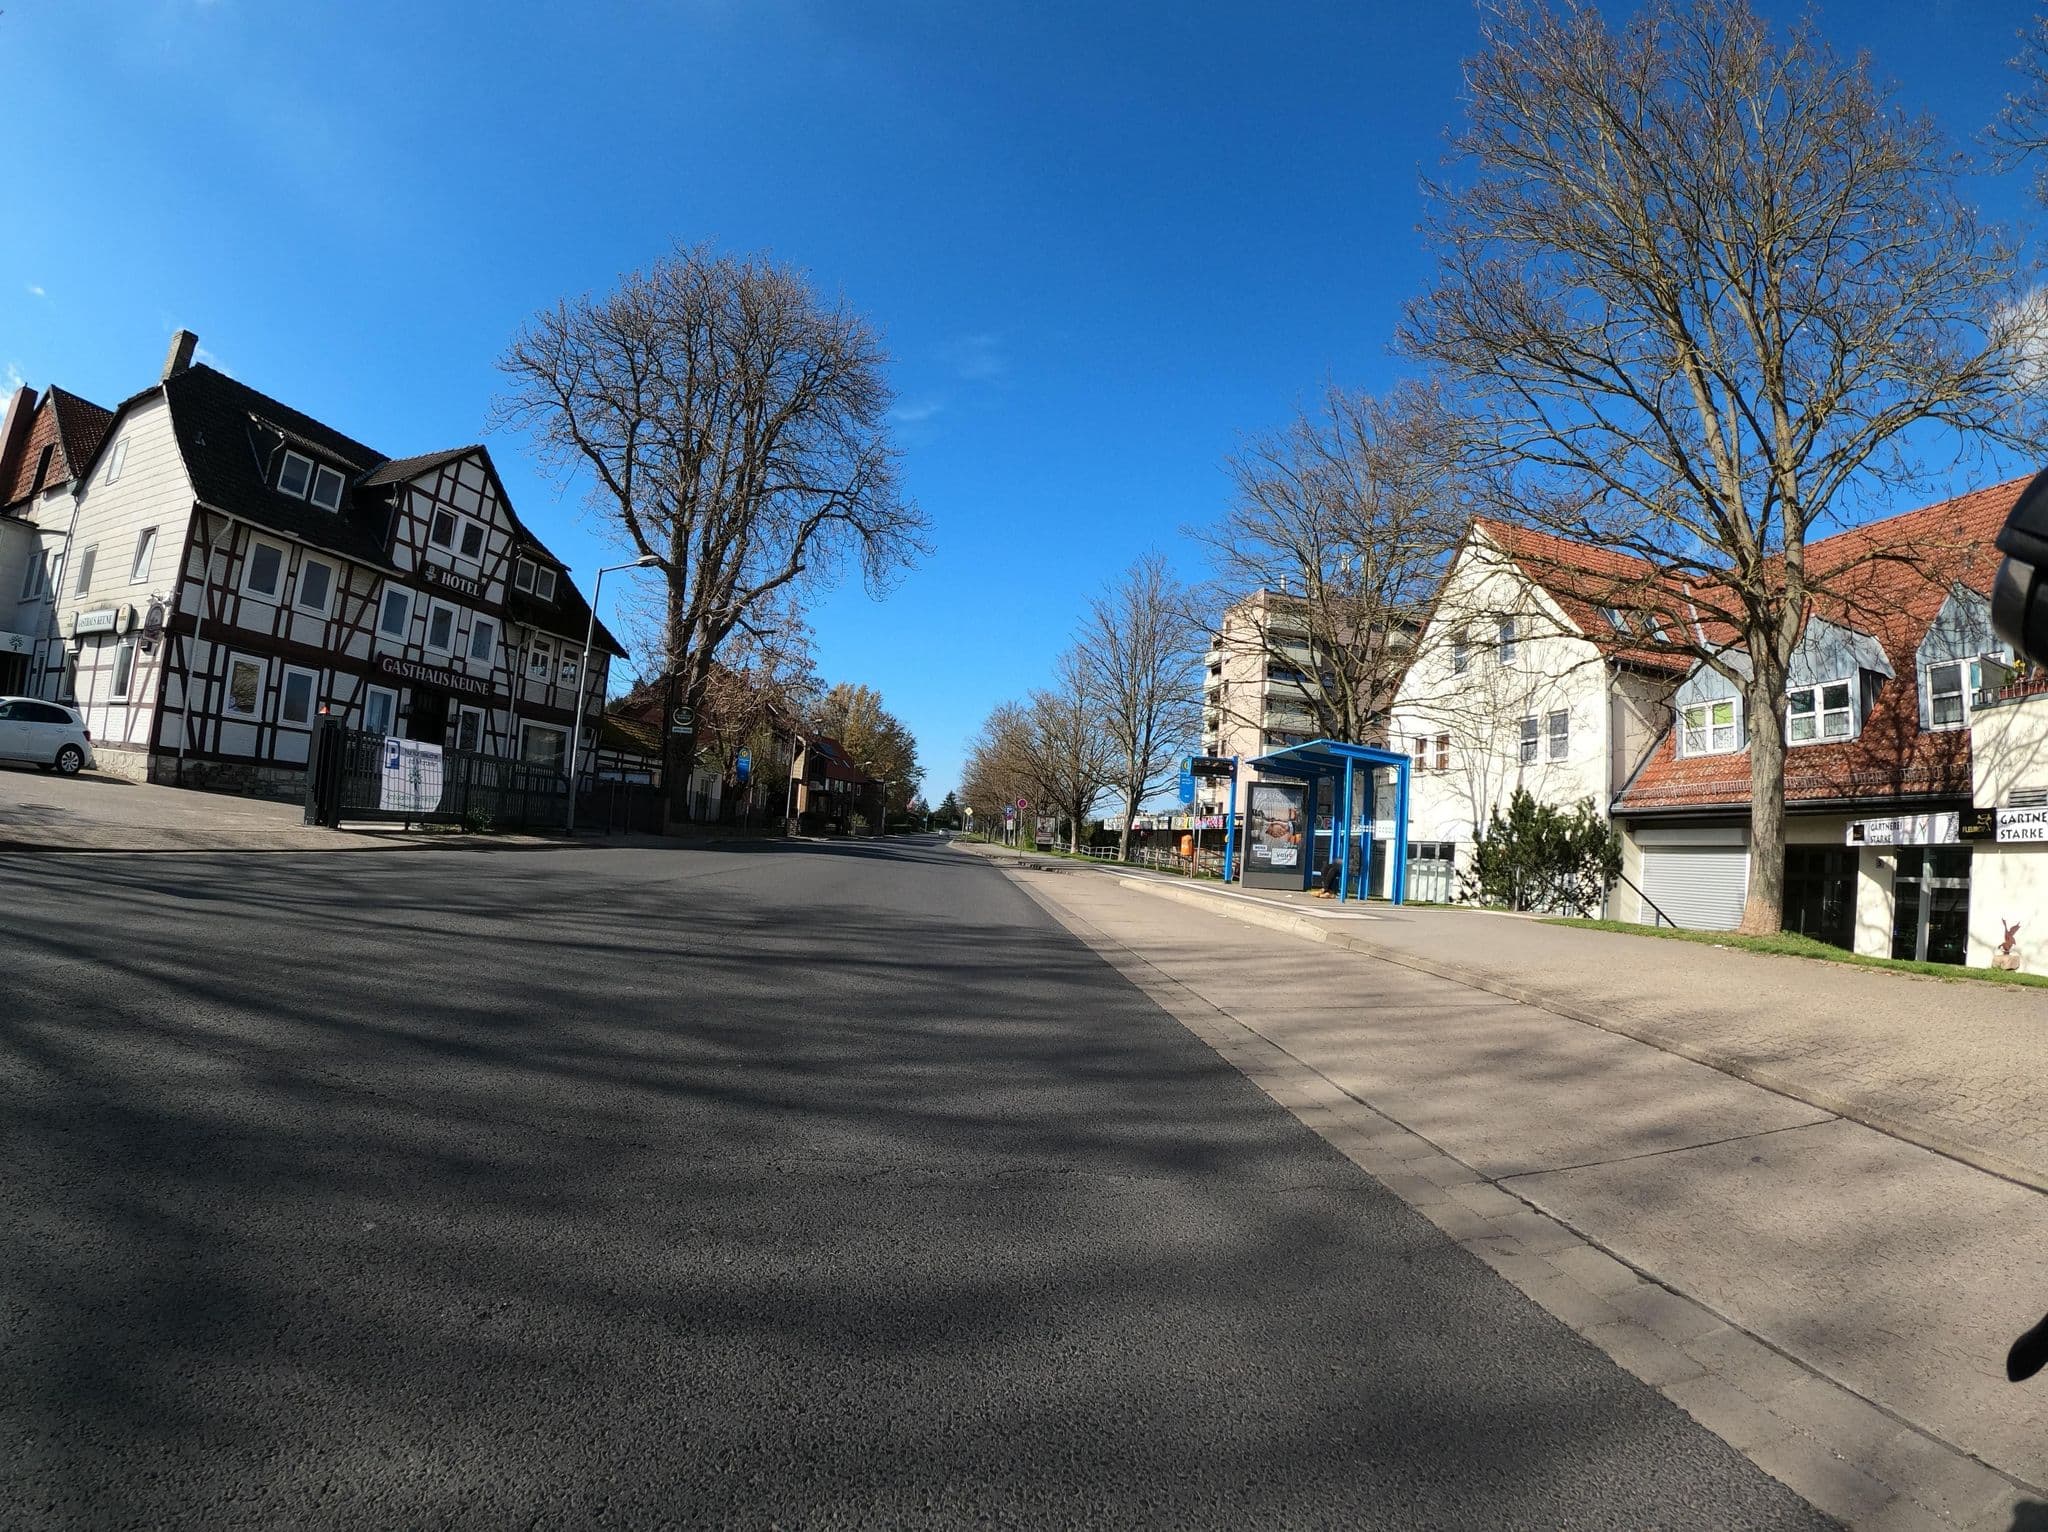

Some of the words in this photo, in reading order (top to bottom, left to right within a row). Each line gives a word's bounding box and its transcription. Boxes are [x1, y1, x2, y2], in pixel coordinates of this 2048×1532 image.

[441, 572, 480, 596] HOTEL
[382, 657, 450, 688] GASTHAUS
[450, 676, 490, 696] KEUNE
[386, 741, 399, 767] P
[1870, 834, 1892, 844] STARKE
[2000, 828, 2044, 840] STARKE
